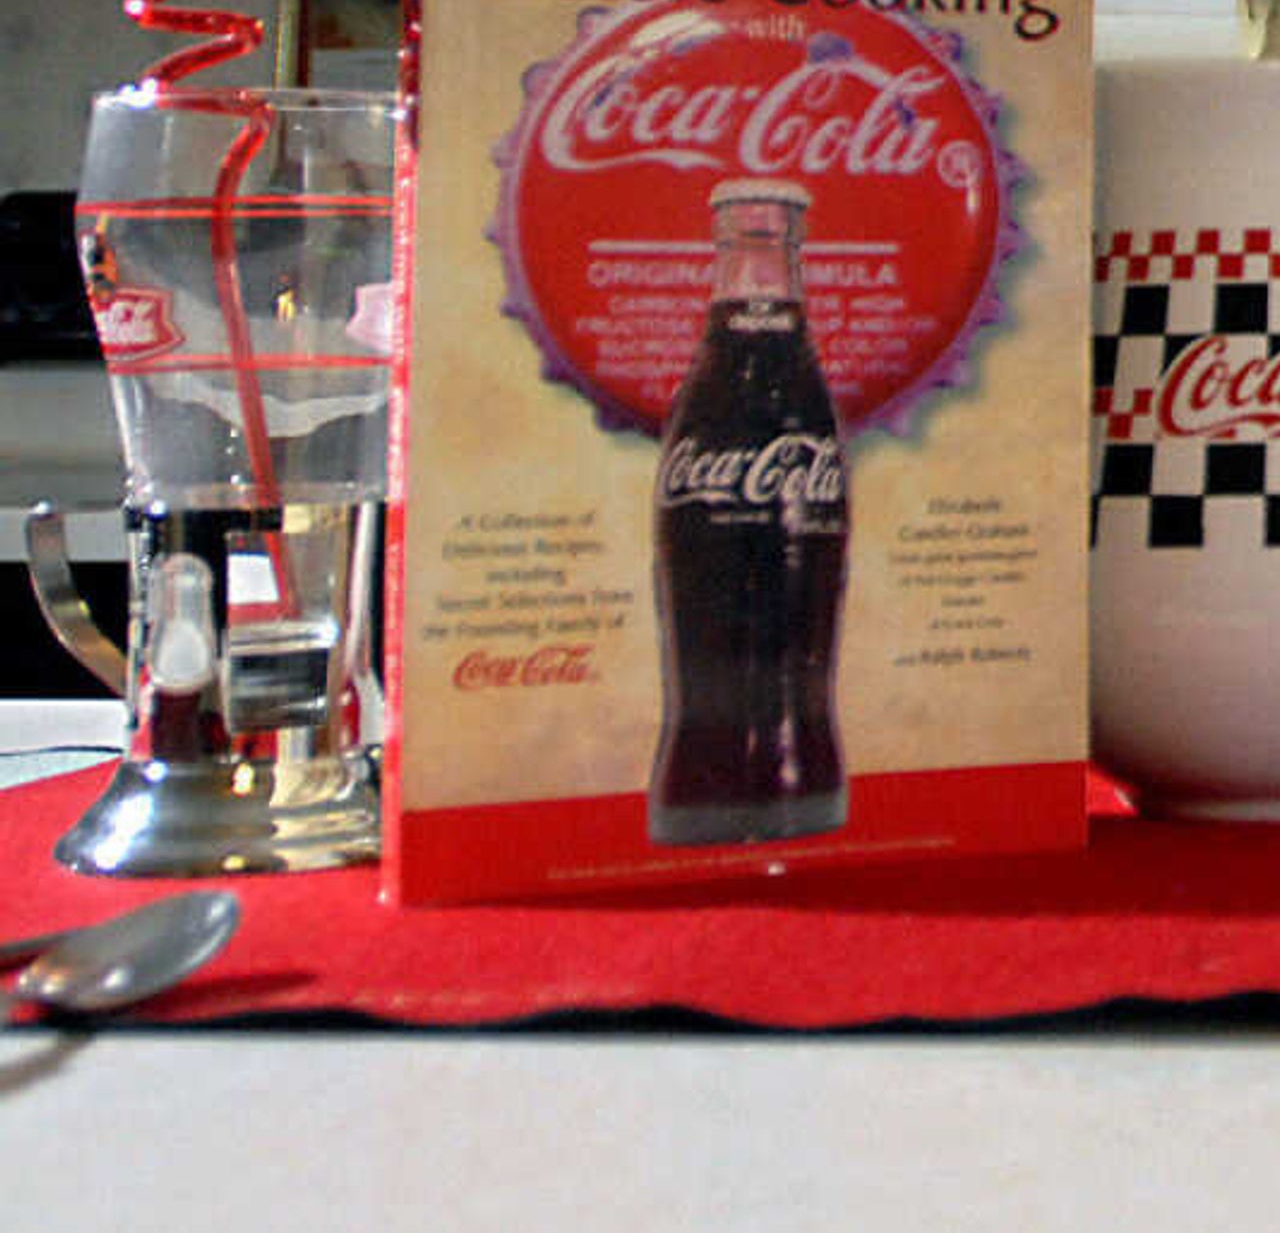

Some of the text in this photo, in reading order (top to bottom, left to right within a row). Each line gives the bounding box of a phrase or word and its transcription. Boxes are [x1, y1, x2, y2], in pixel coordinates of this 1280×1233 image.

[746, 15, 806, 41] with
[541, 56, 946, 174] Coca-Cola
[655, 434, 844, 509] Coca-Cola
[452, 642, 597, 691] Coca-Cola
